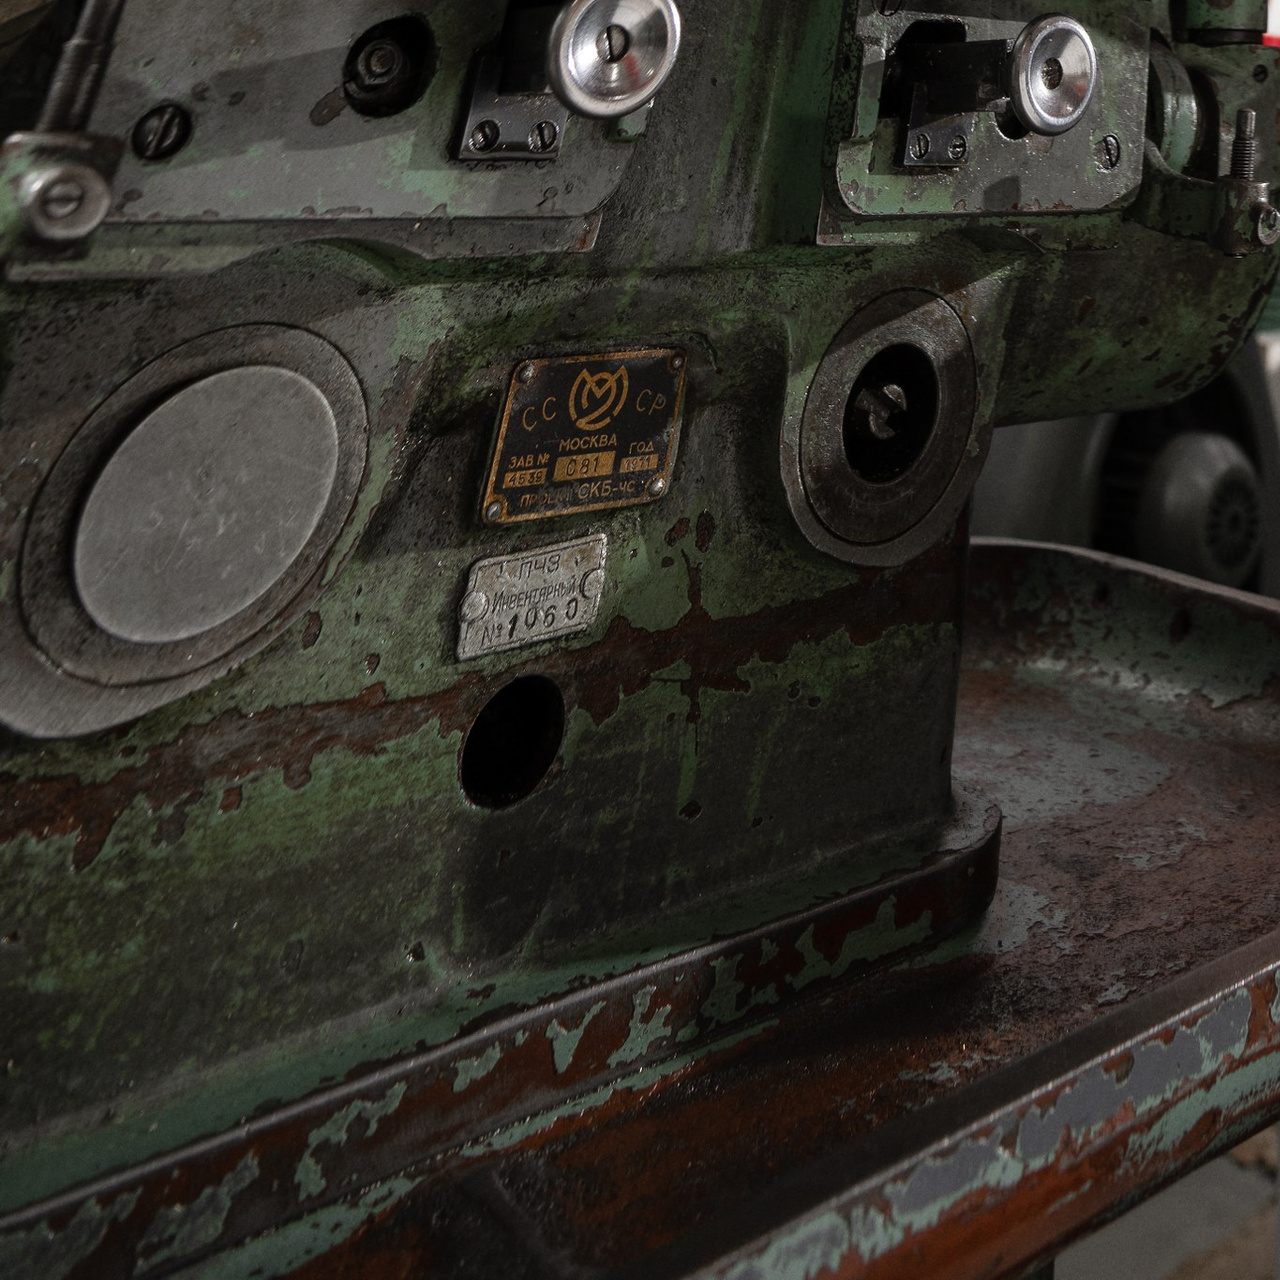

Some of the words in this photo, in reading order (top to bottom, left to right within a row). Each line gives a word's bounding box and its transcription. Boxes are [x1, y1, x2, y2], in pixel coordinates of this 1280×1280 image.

[558, 433, 618, 452] МОСКВА
[629, 441, 655, 454] ГОД
[508, 455, 534, 469] ЗАВ
[508, 472, 543, 487] 4539
[508, 597, 579, 640] 1060
